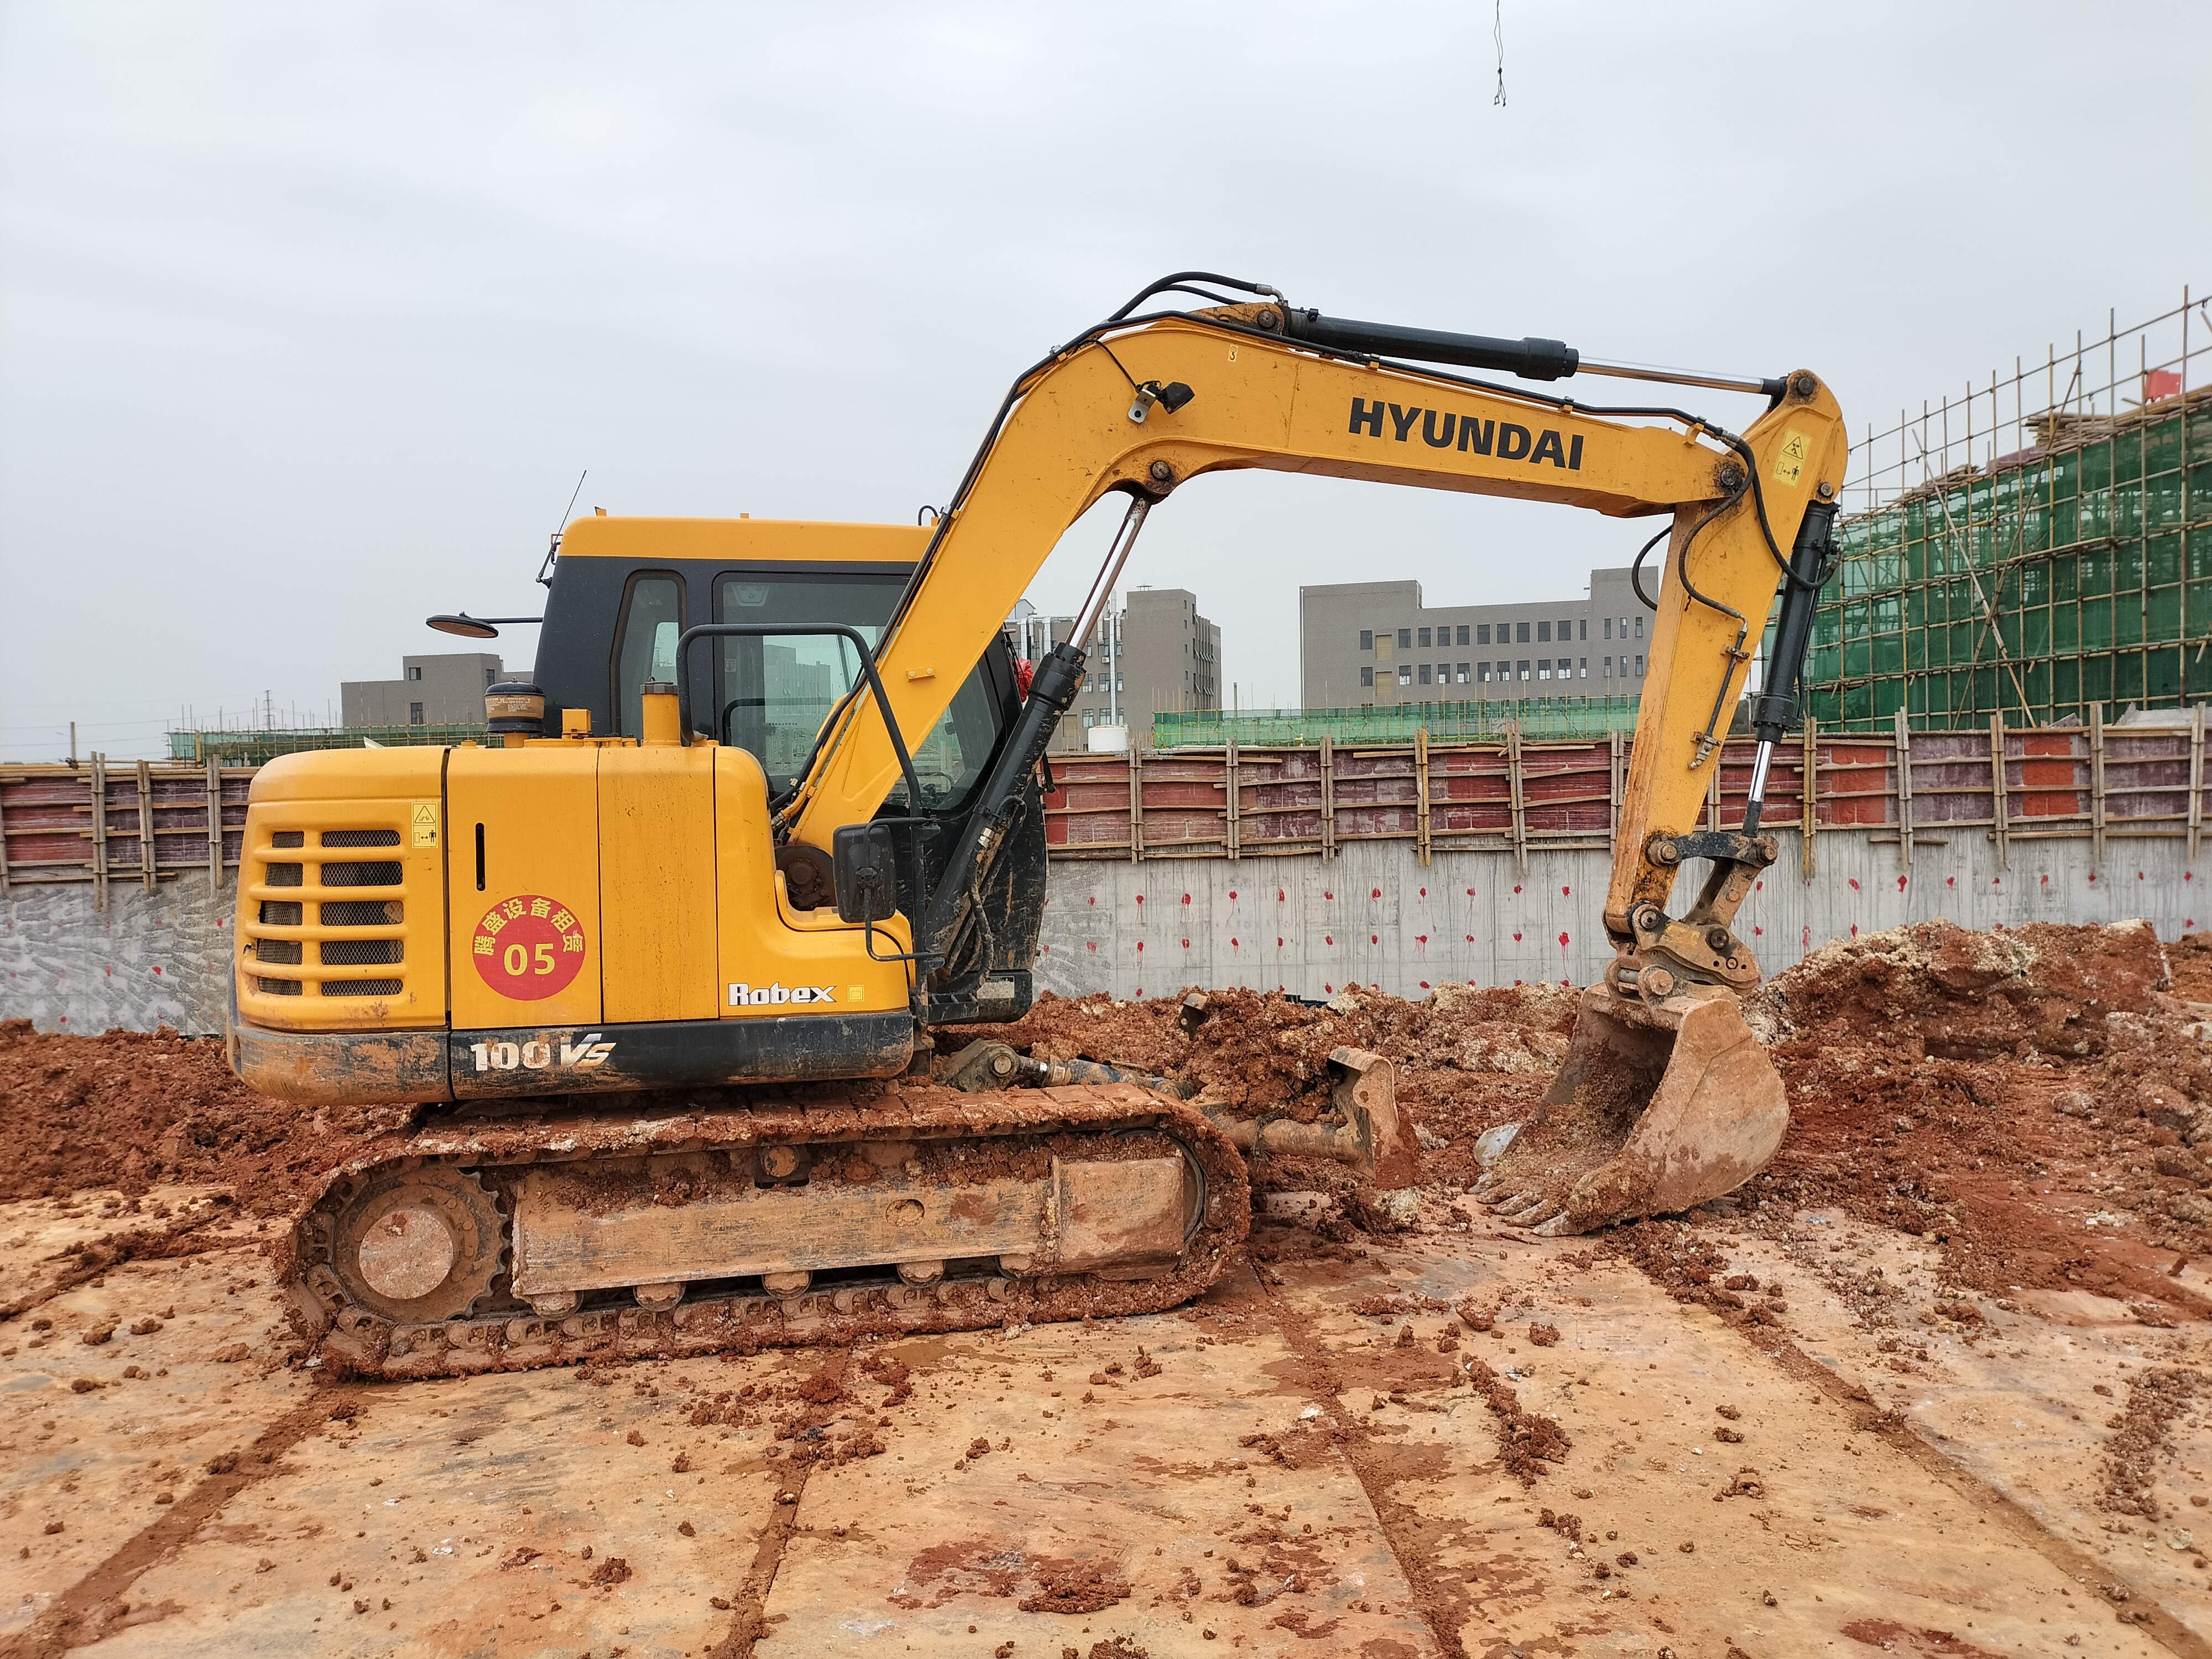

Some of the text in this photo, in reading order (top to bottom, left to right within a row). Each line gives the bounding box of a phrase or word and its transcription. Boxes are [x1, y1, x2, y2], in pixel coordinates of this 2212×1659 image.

[1348, 397, 1584, 471] HYUNDAI
[474, 898, 583, 956] 腾盛设备租赁
[504, 943, 555, 976] 05
[728, 982, 837, 1006] Robex
[470, 1041, 551, 1071] 100
